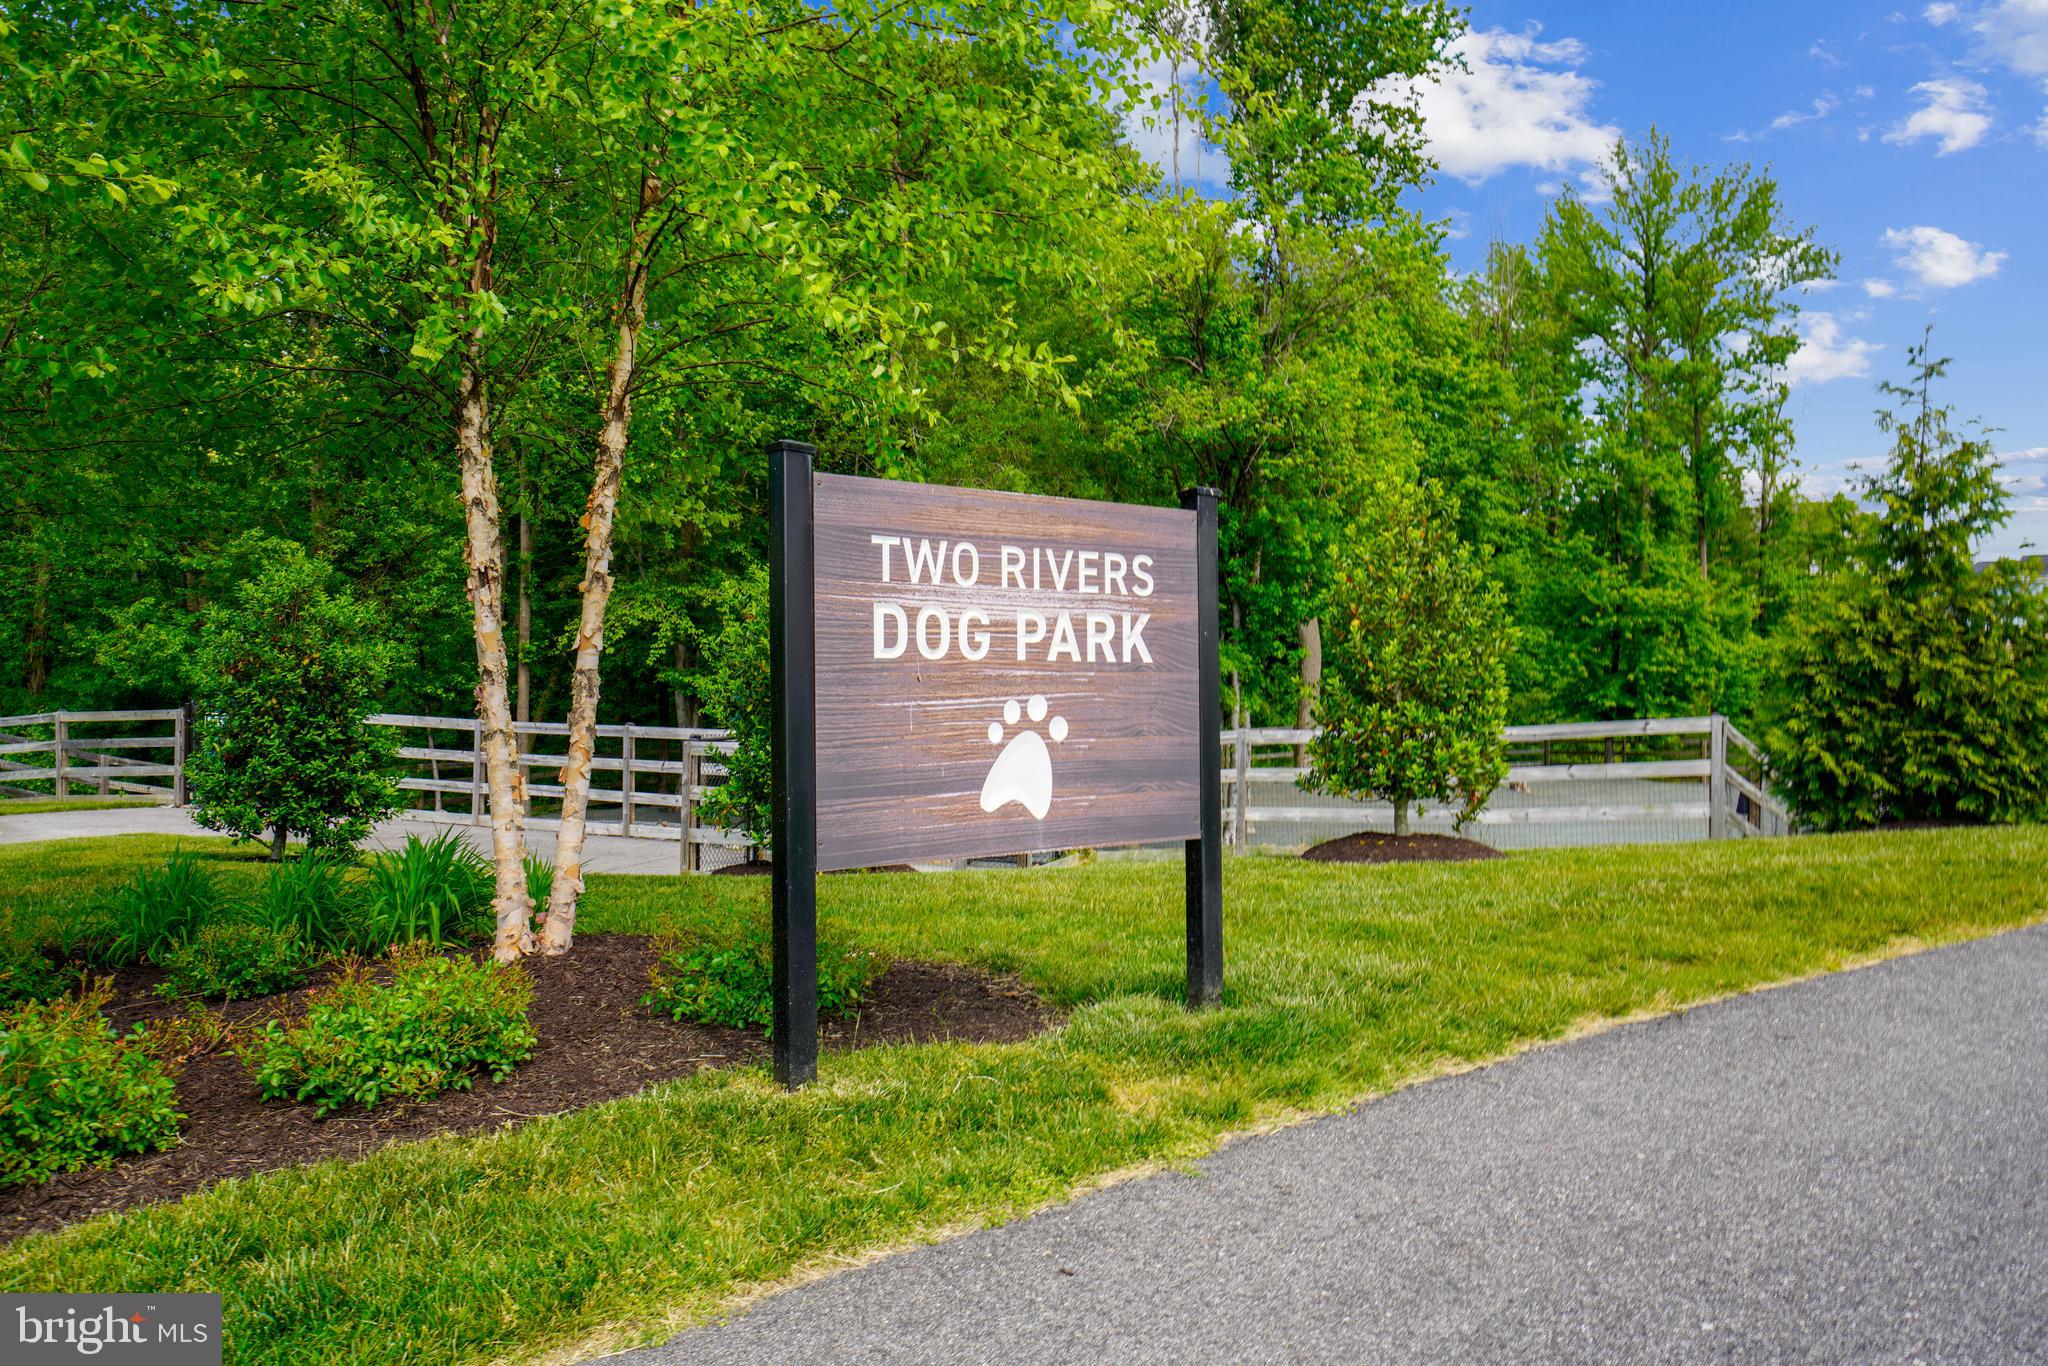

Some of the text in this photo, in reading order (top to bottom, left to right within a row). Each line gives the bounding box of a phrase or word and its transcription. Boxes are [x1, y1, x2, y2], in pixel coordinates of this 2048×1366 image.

[871, 534, 1155, 597] TWO RIVERS
[873, 601, 1154, 664] DOG PARK
